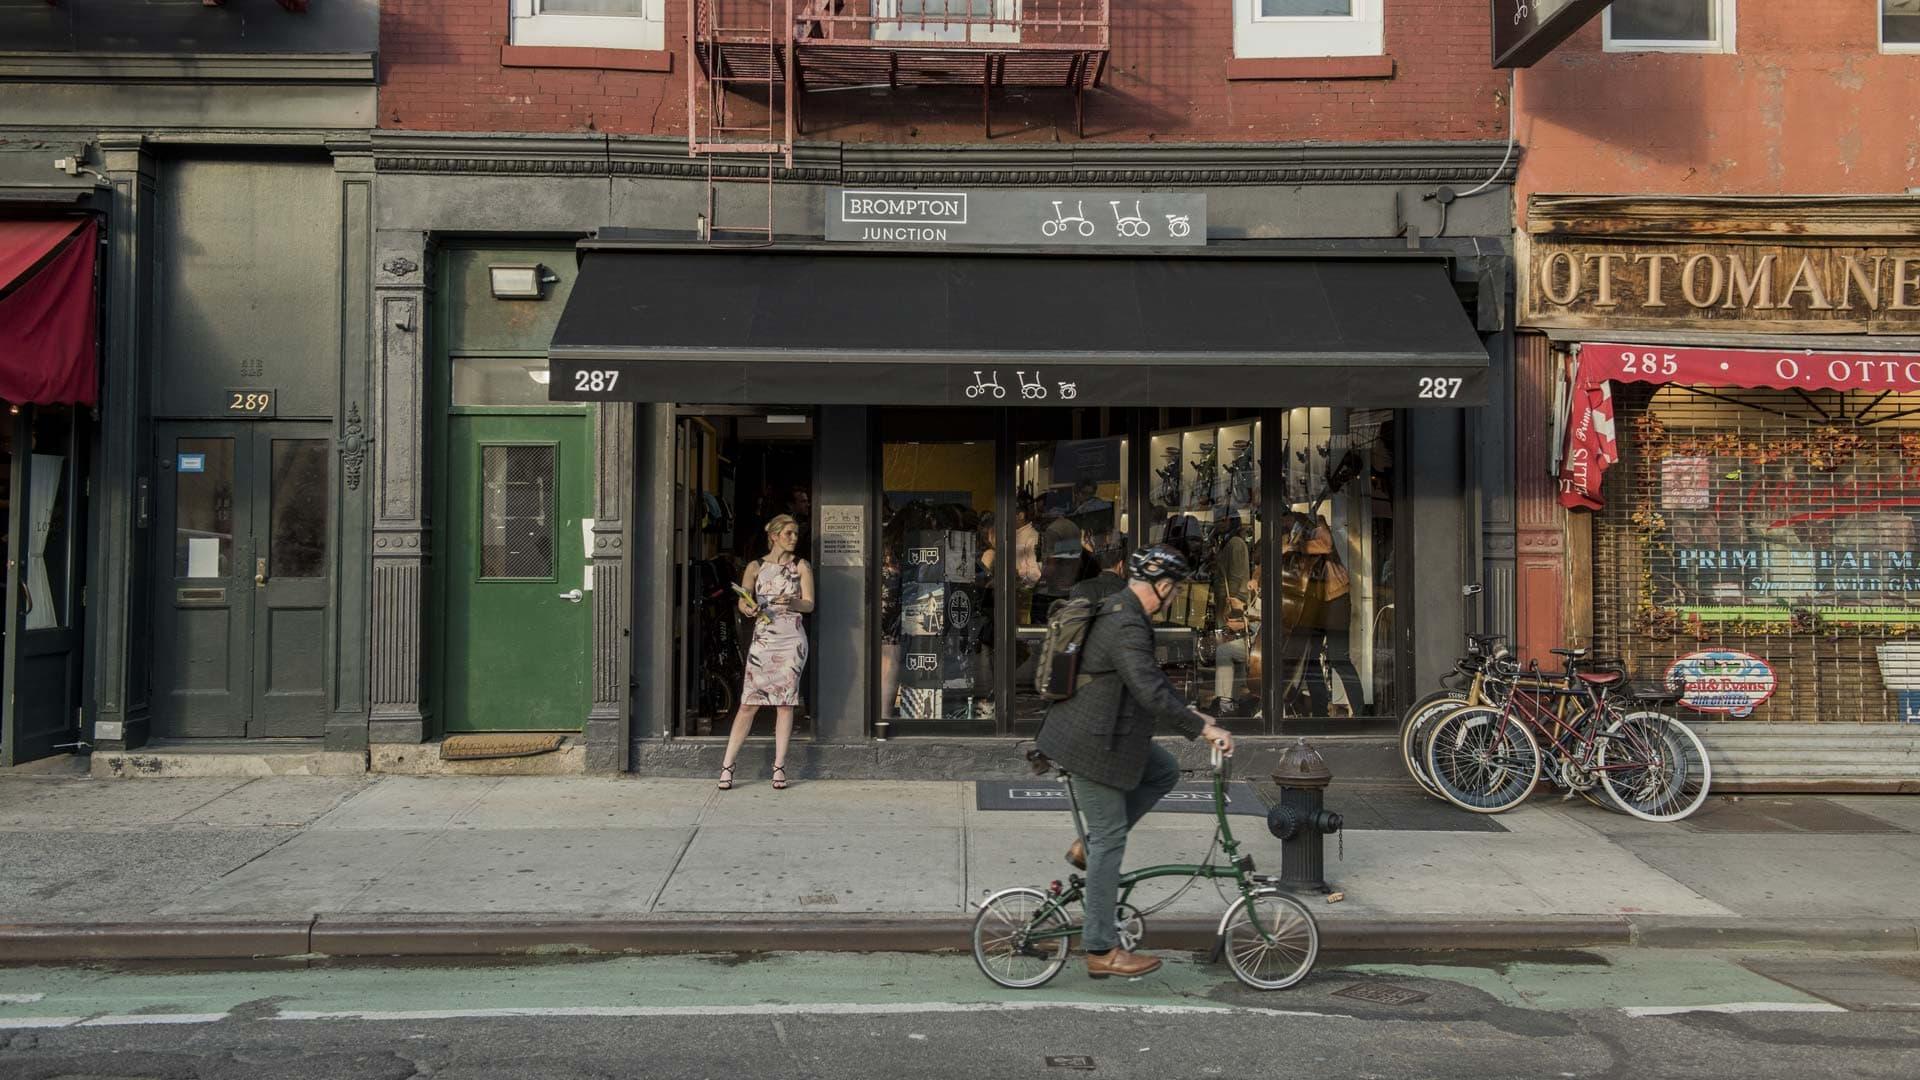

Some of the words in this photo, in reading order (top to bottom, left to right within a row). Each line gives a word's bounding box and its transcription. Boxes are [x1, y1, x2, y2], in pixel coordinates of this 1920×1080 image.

[850, 199, 959, 216] BROMPTON
[862, 227, 947, 241] JUNCTION
[1540, 251, 1920, 311] OTTOMANE
[1620, 351, 1678, 375] 285
[1775, 358, 1811, 381] O.
[1827, 359, 1920, 383] OTTO
[574, 370, 619, 392] 287
[1418, 377, 1463, 399] 287
[230, 393, 269, 413] 289
[1887, 551, 1920, 569] M
[1024, 791, 1214, 800] BRON
